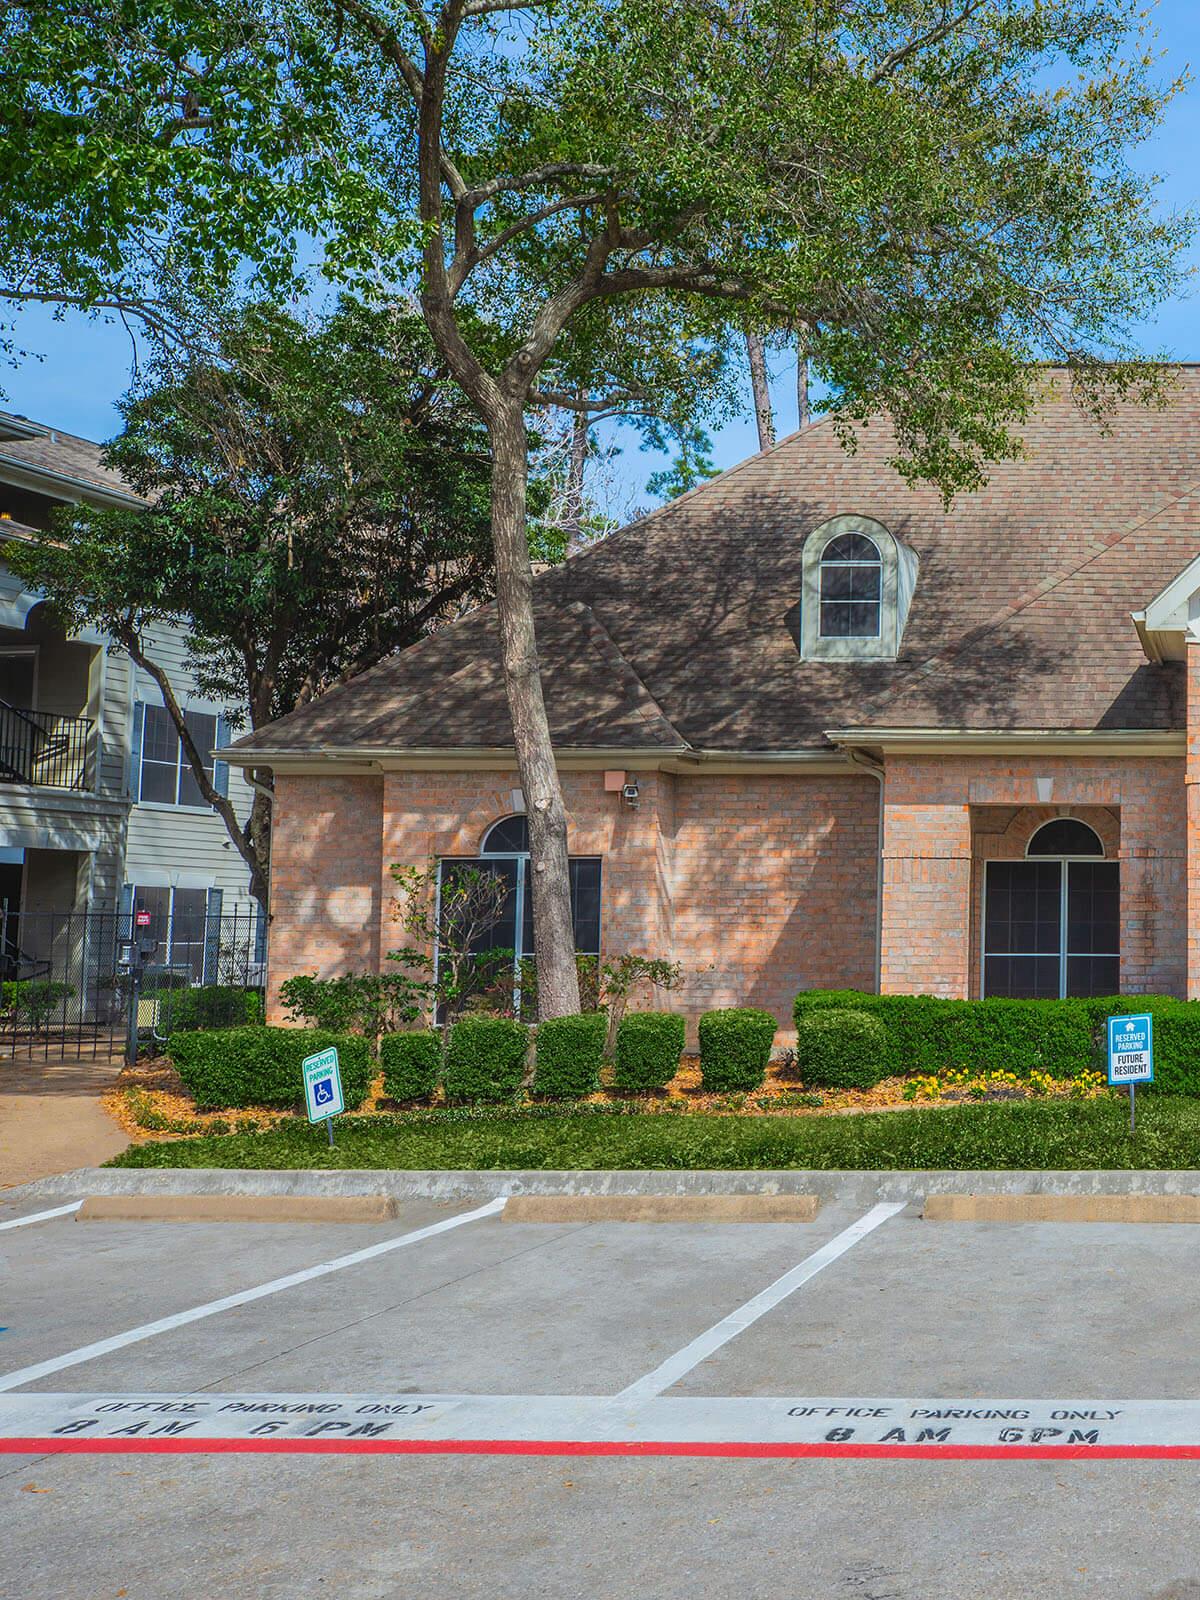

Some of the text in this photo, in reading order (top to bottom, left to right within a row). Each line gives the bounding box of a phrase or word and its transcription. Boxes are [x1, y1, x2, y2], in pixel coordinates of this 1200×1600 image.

[1116, 1032, 1145, 1042] RESERVED
[1118, 1041, 1143, 1051] PARKING
[306, 1055, 334, 1072] RESERVED
[1118, 1053, 1143, 1064] FUTURE
[309, 1067, 333, 1081] PARKING
[1115, 1064, 1147, 1075] RESIDENT
[95, 1402, 435, 1414] OFFICE PARKING ONLY
[787, 1407, 1123, 1420] OFFICE PARKING ONLY
[53, 1419, 99, 1434] 8
[249, 1421, 288, 1435] 6
[304, 1421, 394, 1437] PM
[824, 1427, 855, 1442] 8
[878, 1427, 952, 1443] AM
